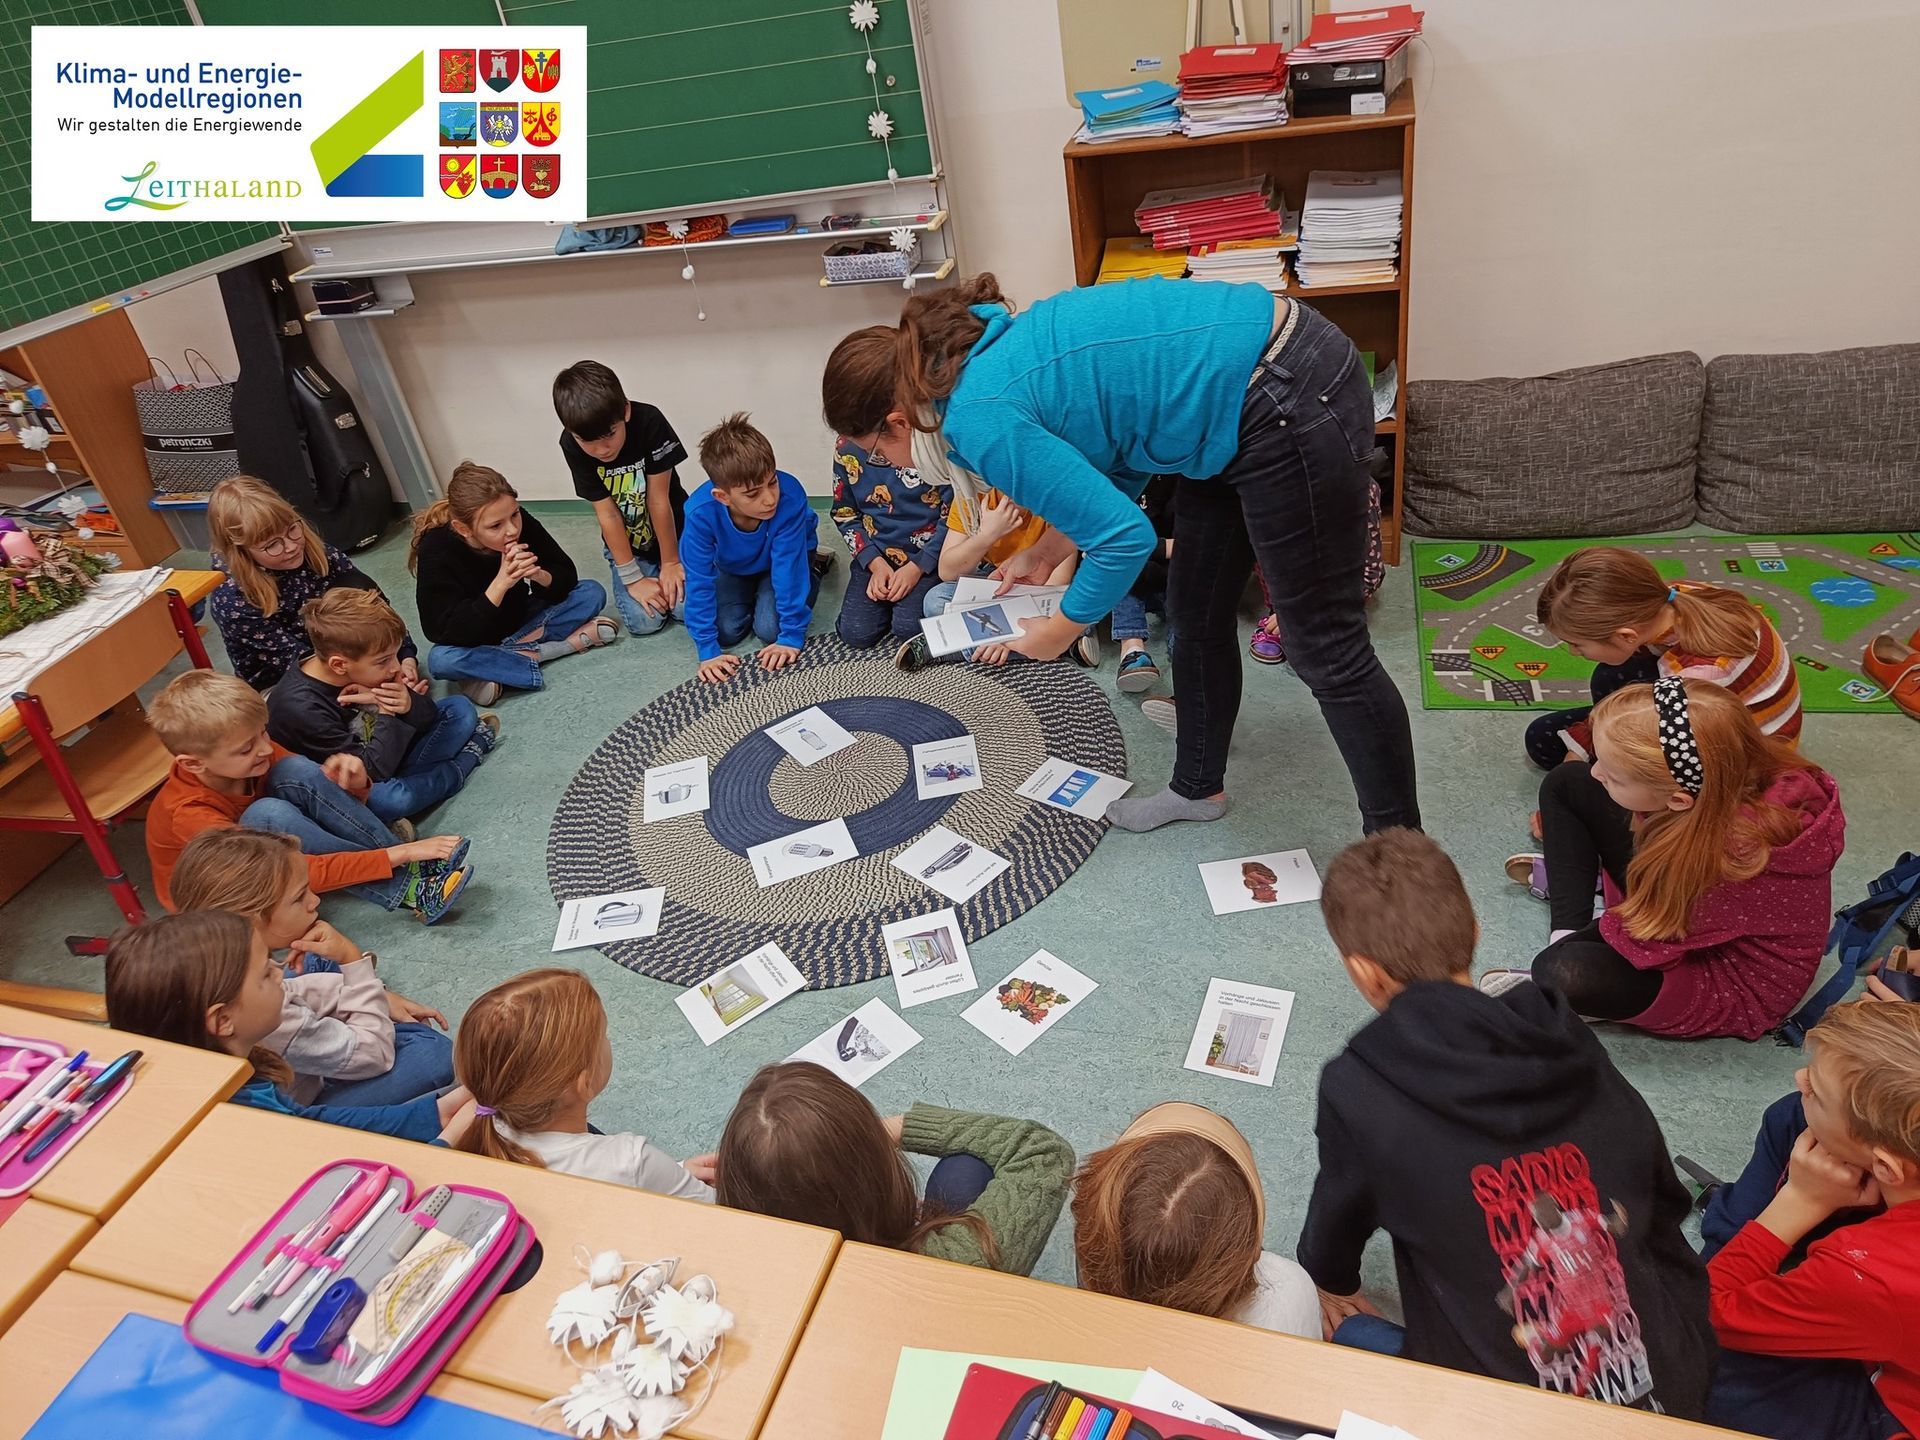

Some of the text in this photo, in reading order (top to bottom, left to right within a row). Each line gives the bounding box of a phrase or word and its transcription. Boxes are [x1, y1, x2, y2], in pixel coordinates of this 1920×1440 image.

[606, 466, 626, 476] PURE
[1221, 991, 1244, 1000] Vorhänge
[1171, 1400, 1184, 1411] 20
